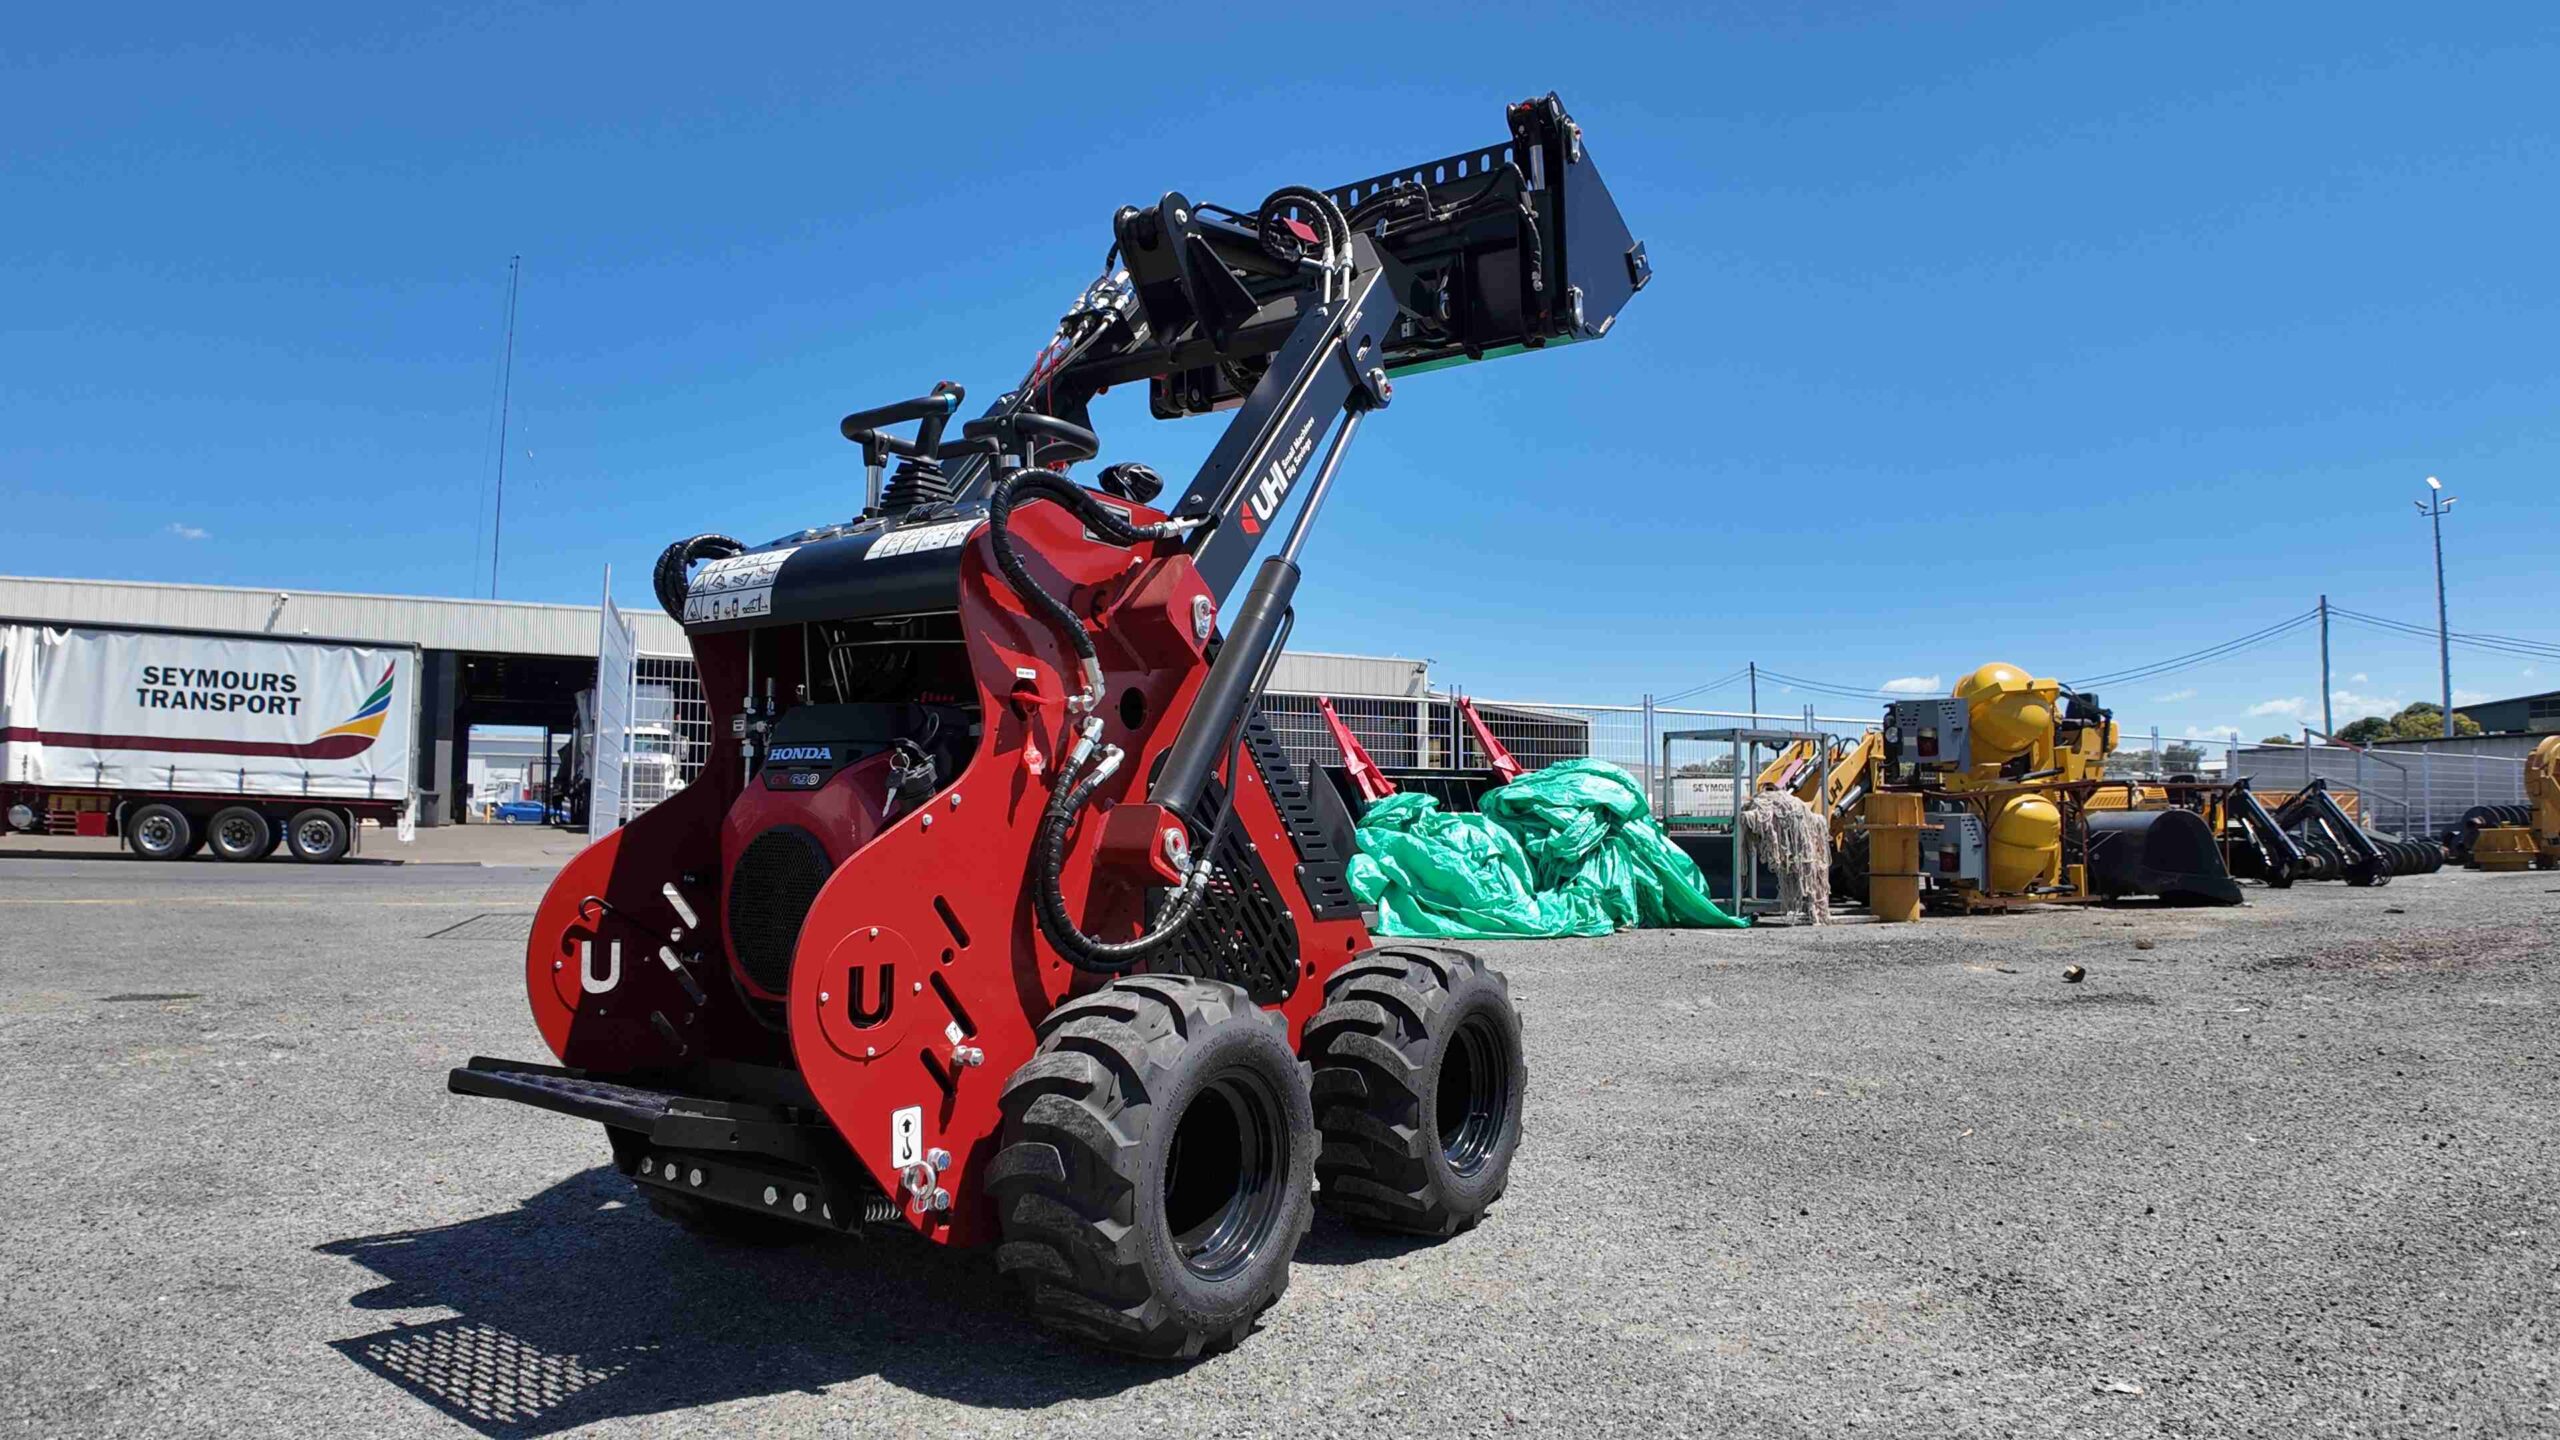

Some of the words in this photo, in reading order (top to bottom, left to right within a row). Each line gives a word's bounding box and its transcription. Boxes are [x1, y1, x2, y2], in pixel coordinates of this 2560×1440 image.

[1281, 445, 1296, 470] Small
[1293, 416, 1315, 450] Machines
[1286, 464, 1297, 479] Big
[1294, 438, 1312, 466] Savings
[1251, 460, 1288, 520] UHI
[142, 666, 297, 693] SEYMOURS
[136, 688, 302, 716] TRANSPORT
[768, 747, 832, 760] HONDA
[1692, 783, 1736, 793] SEYMOUR
[581, 939, 621, 993] U
[848, 963, 895, 1030] U
